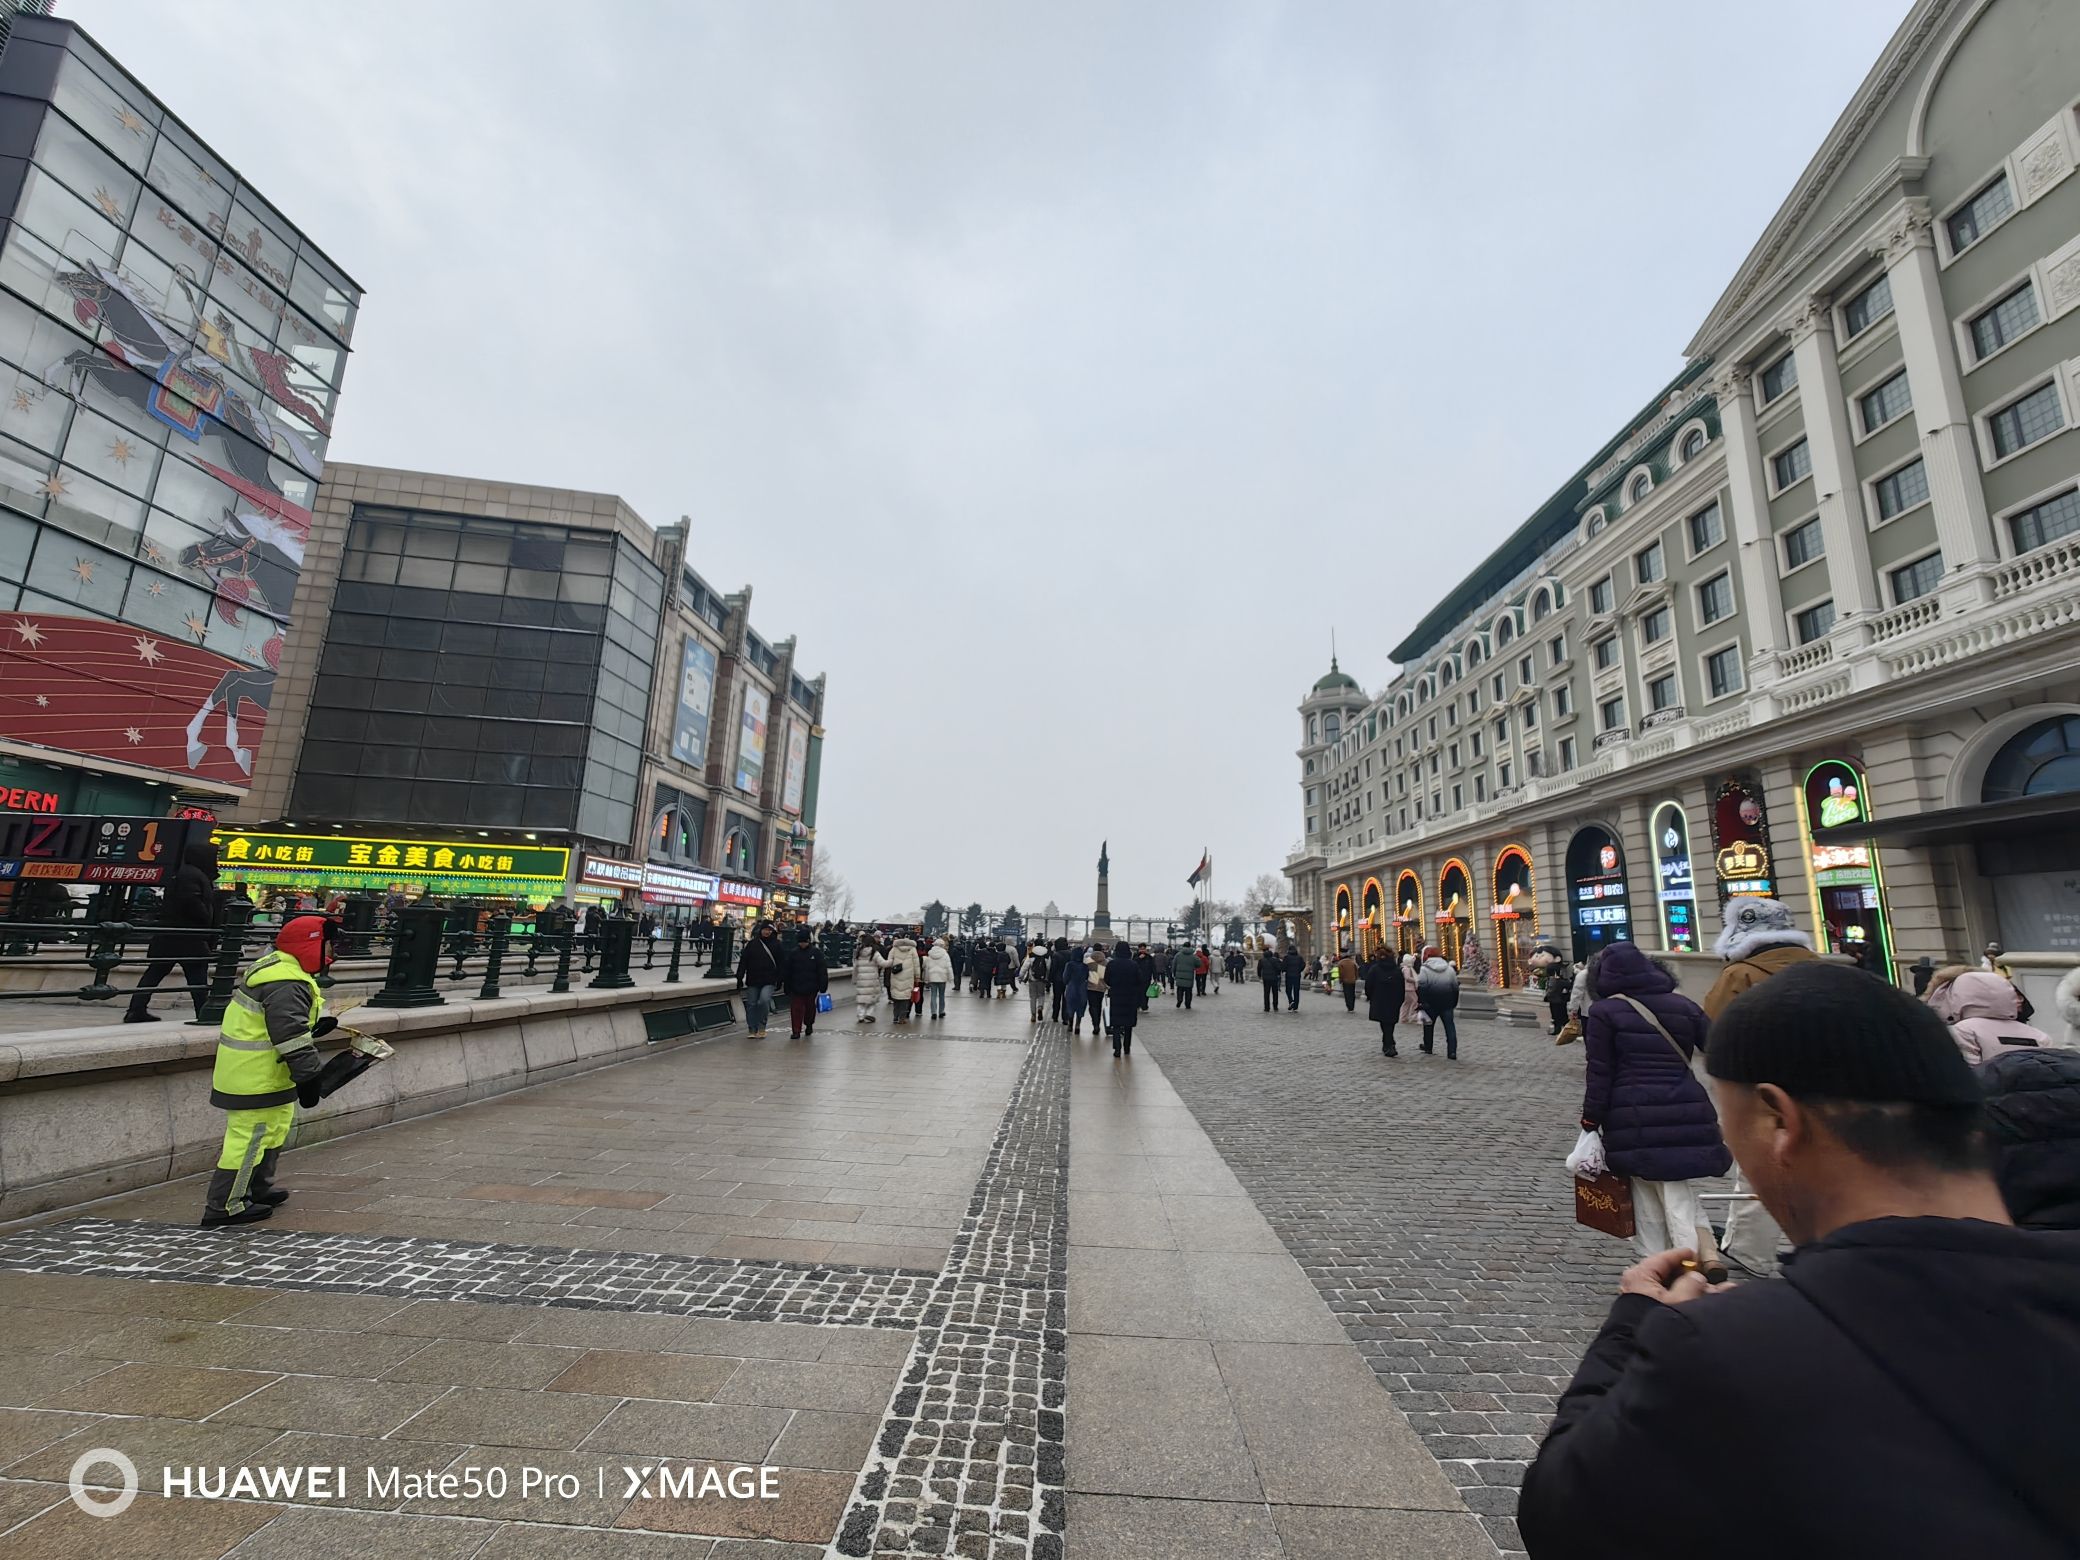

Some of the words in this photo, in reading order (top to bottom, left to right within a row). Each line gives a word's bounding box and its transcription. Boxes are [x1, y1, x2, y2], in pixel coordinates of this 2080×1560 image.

[210, 836, 314, 862] 食小吃街
[348, 844, 513, 871] 宝金美食小吃街
